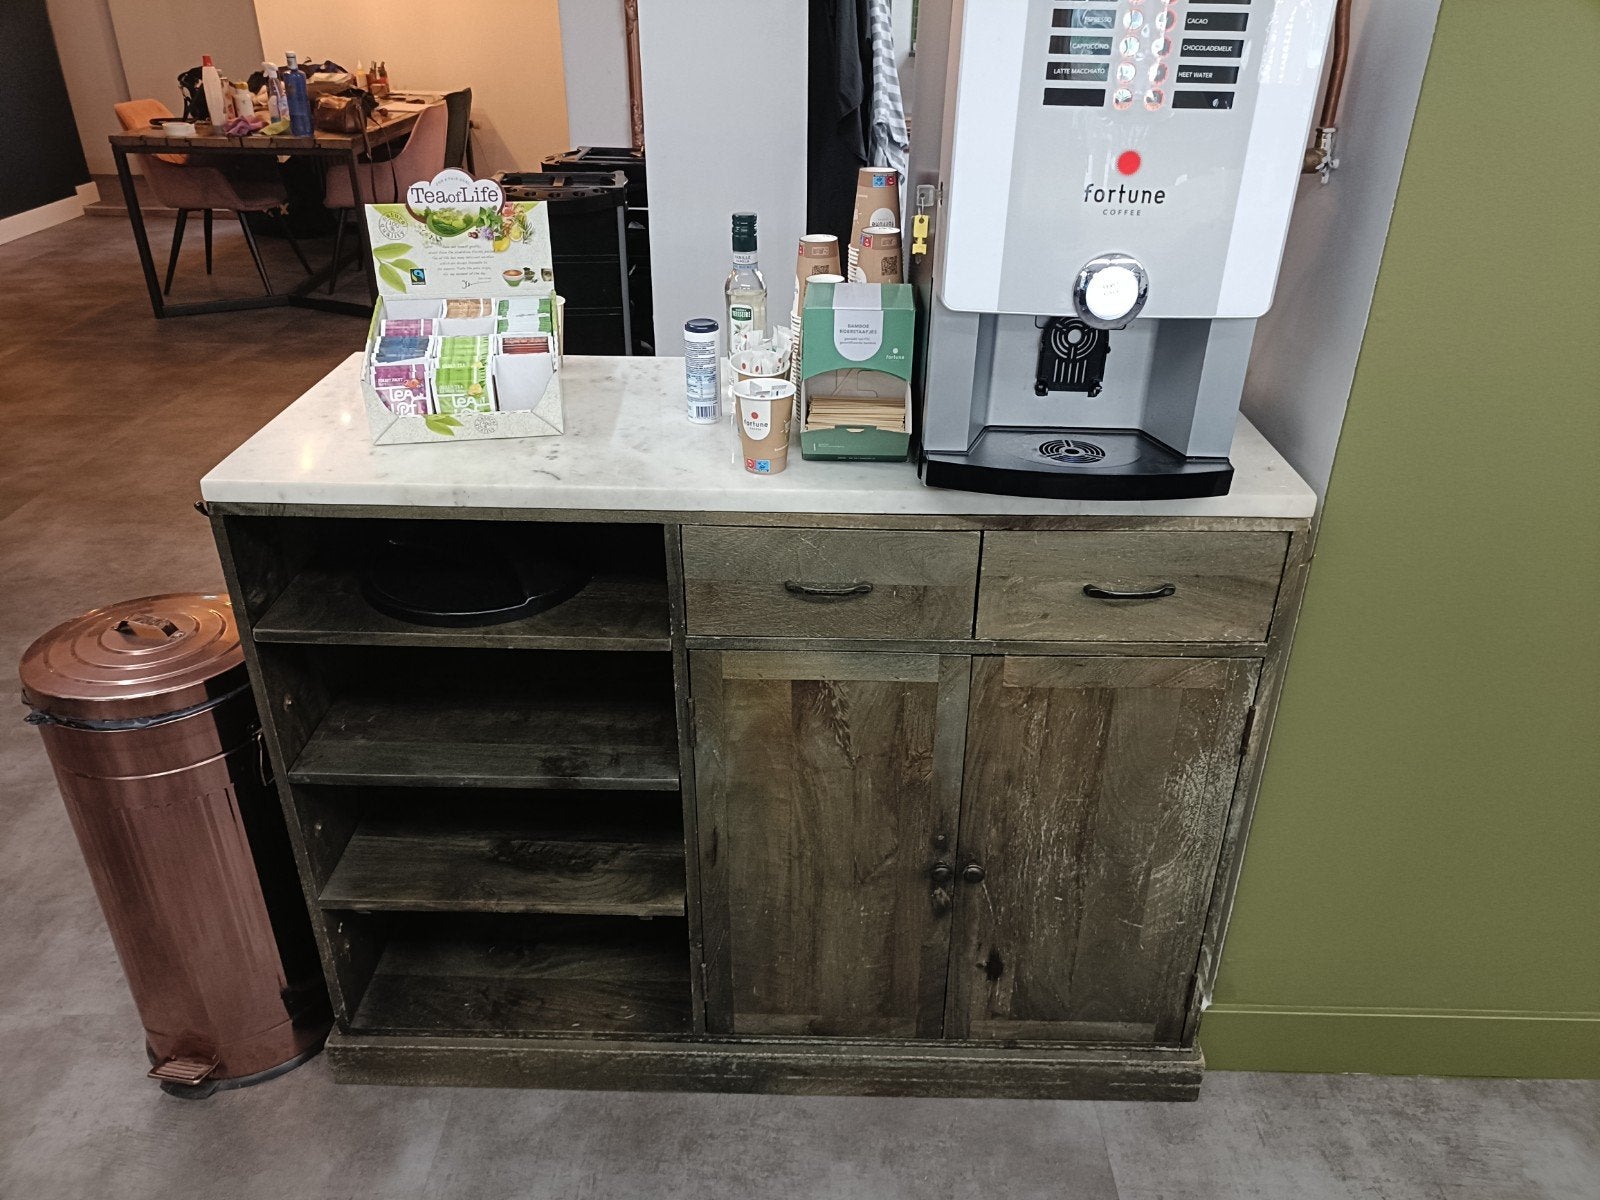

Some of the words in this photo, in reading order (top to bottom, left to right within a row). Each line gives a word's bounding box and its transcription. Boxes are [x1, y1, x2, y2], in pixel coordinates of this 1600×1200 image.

[1182, 44, 1233, 52] CHOCOLADEMELK
[1084, 183, 1166, 204] fortune
[743, 419, 768, 428] fortune
